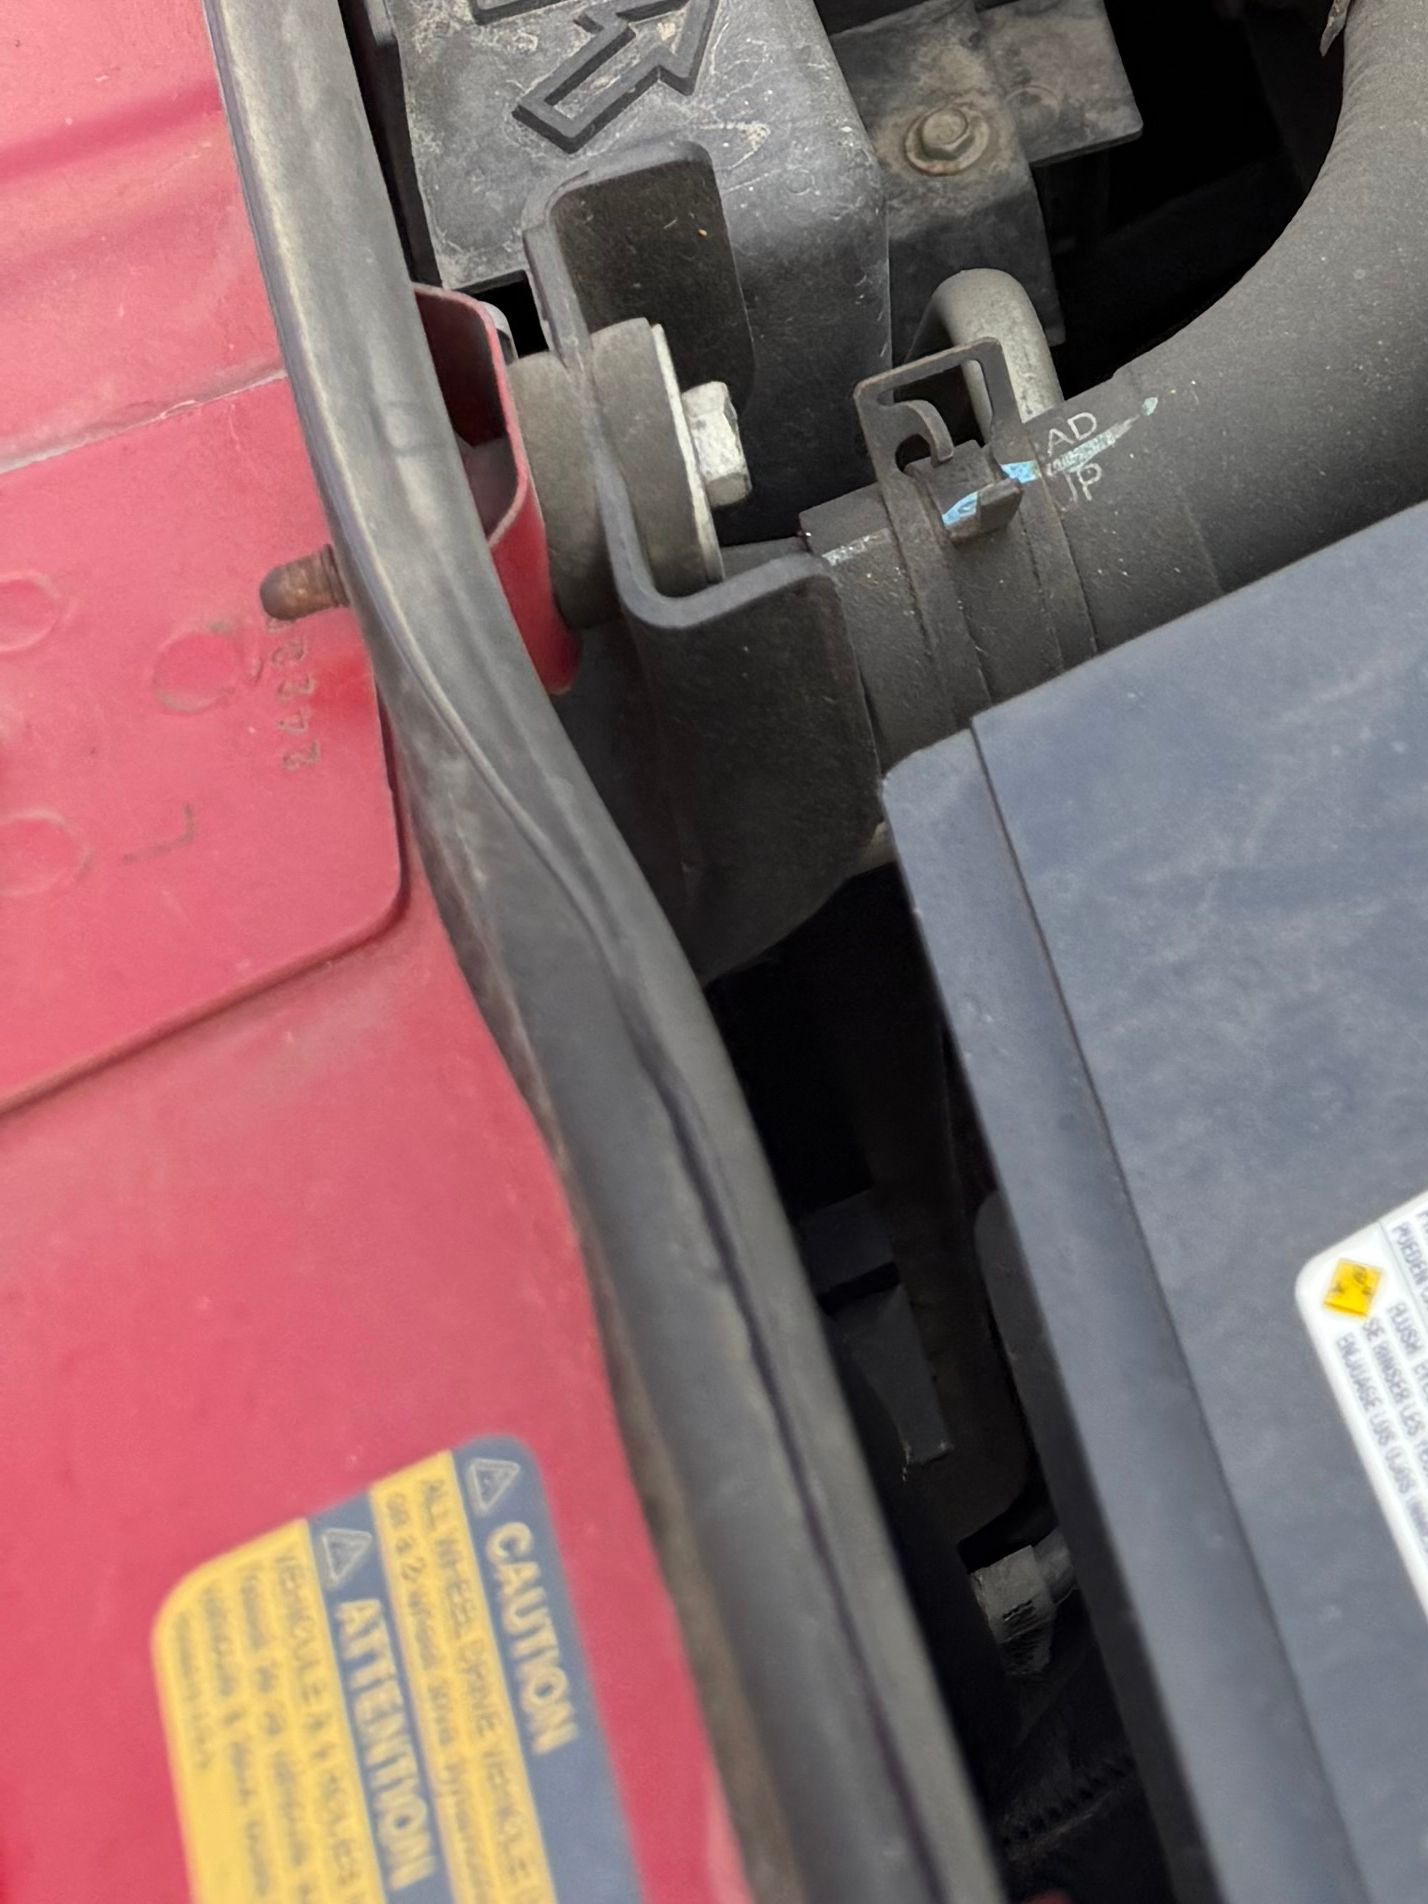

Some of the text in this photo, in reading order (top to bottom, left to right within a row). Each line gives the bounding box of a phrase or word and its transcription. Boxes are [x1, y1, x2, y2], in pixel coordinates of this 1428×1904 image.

[1047, 411, 1097, 452] AD
[433, 1537, 478, 1638] WHEEL
[482, 1523, 579, 1752] CAUTION
[328, 1601, 442, 1885] ATTENTION
